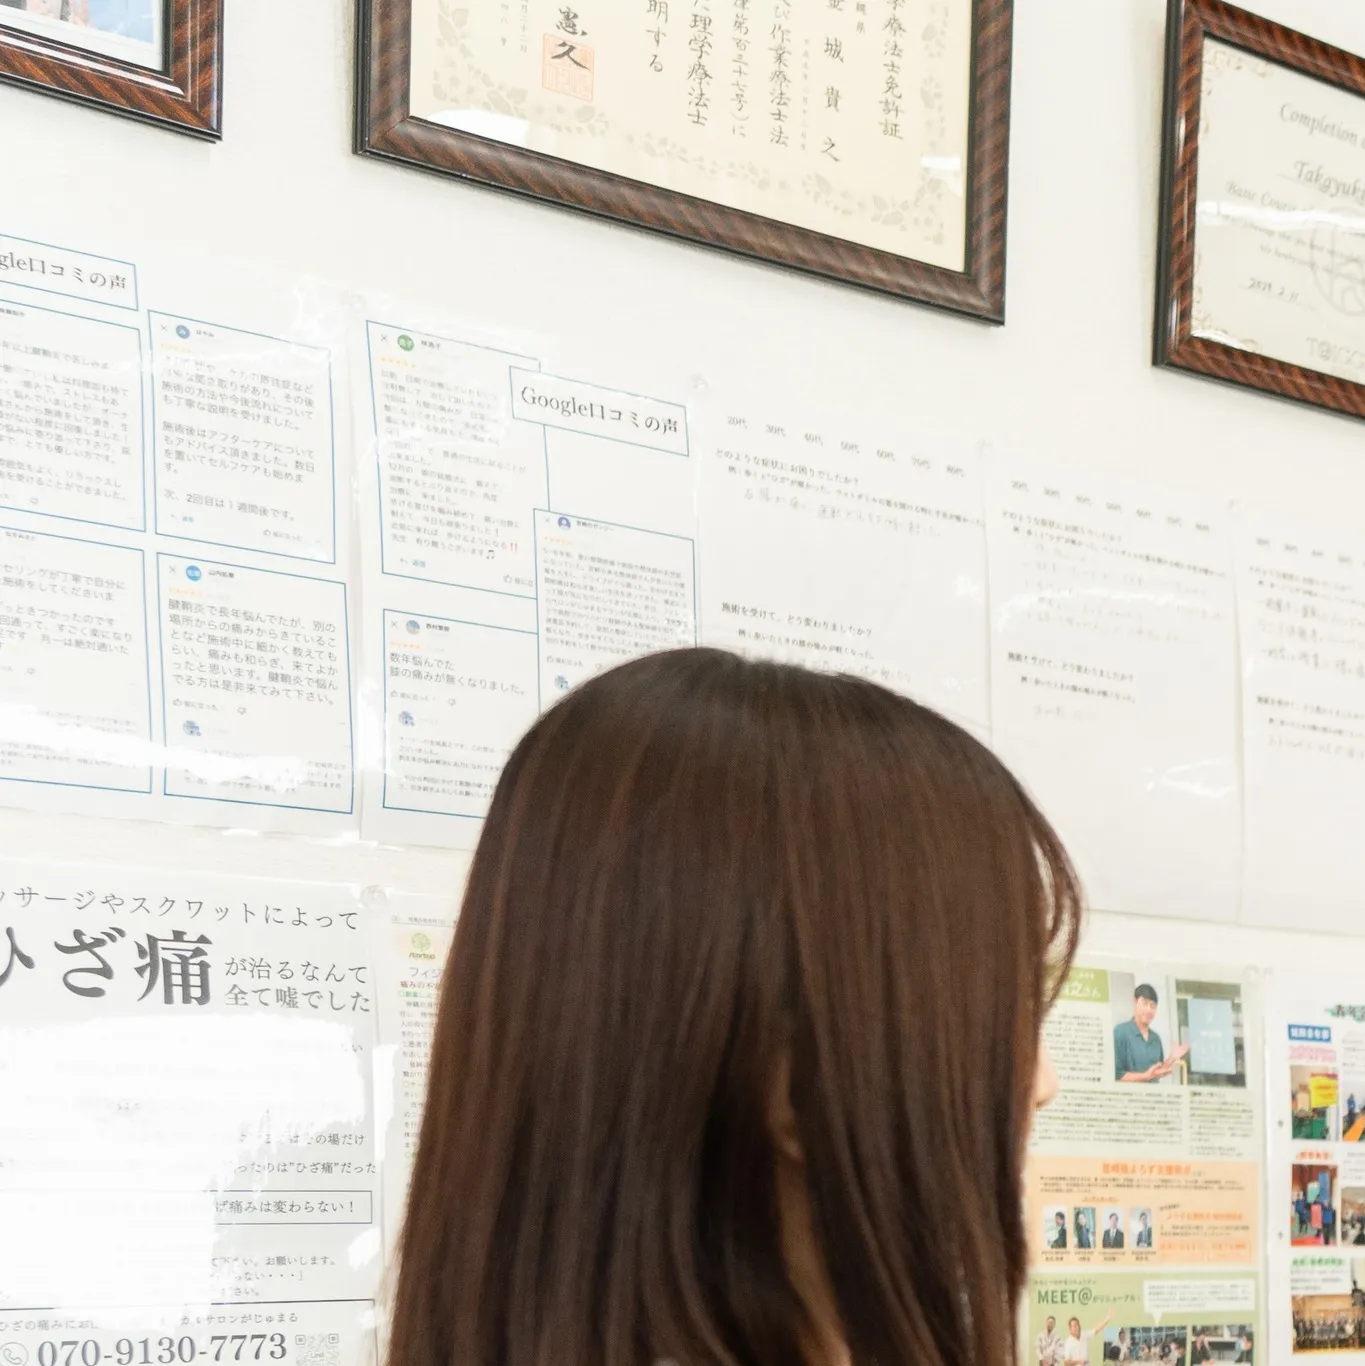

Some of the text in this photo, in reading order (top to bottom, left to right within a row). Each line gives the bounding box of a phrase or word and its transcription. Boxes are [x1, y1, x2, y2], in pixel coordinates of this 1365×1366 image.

[1279, 102, 1358, 147] Completion
[520, 385, 678, 434] Google口コミの声
[224, 956, 369, 985] が治るなんて
[224, 983, 371, 1013] 全て嘘でした
